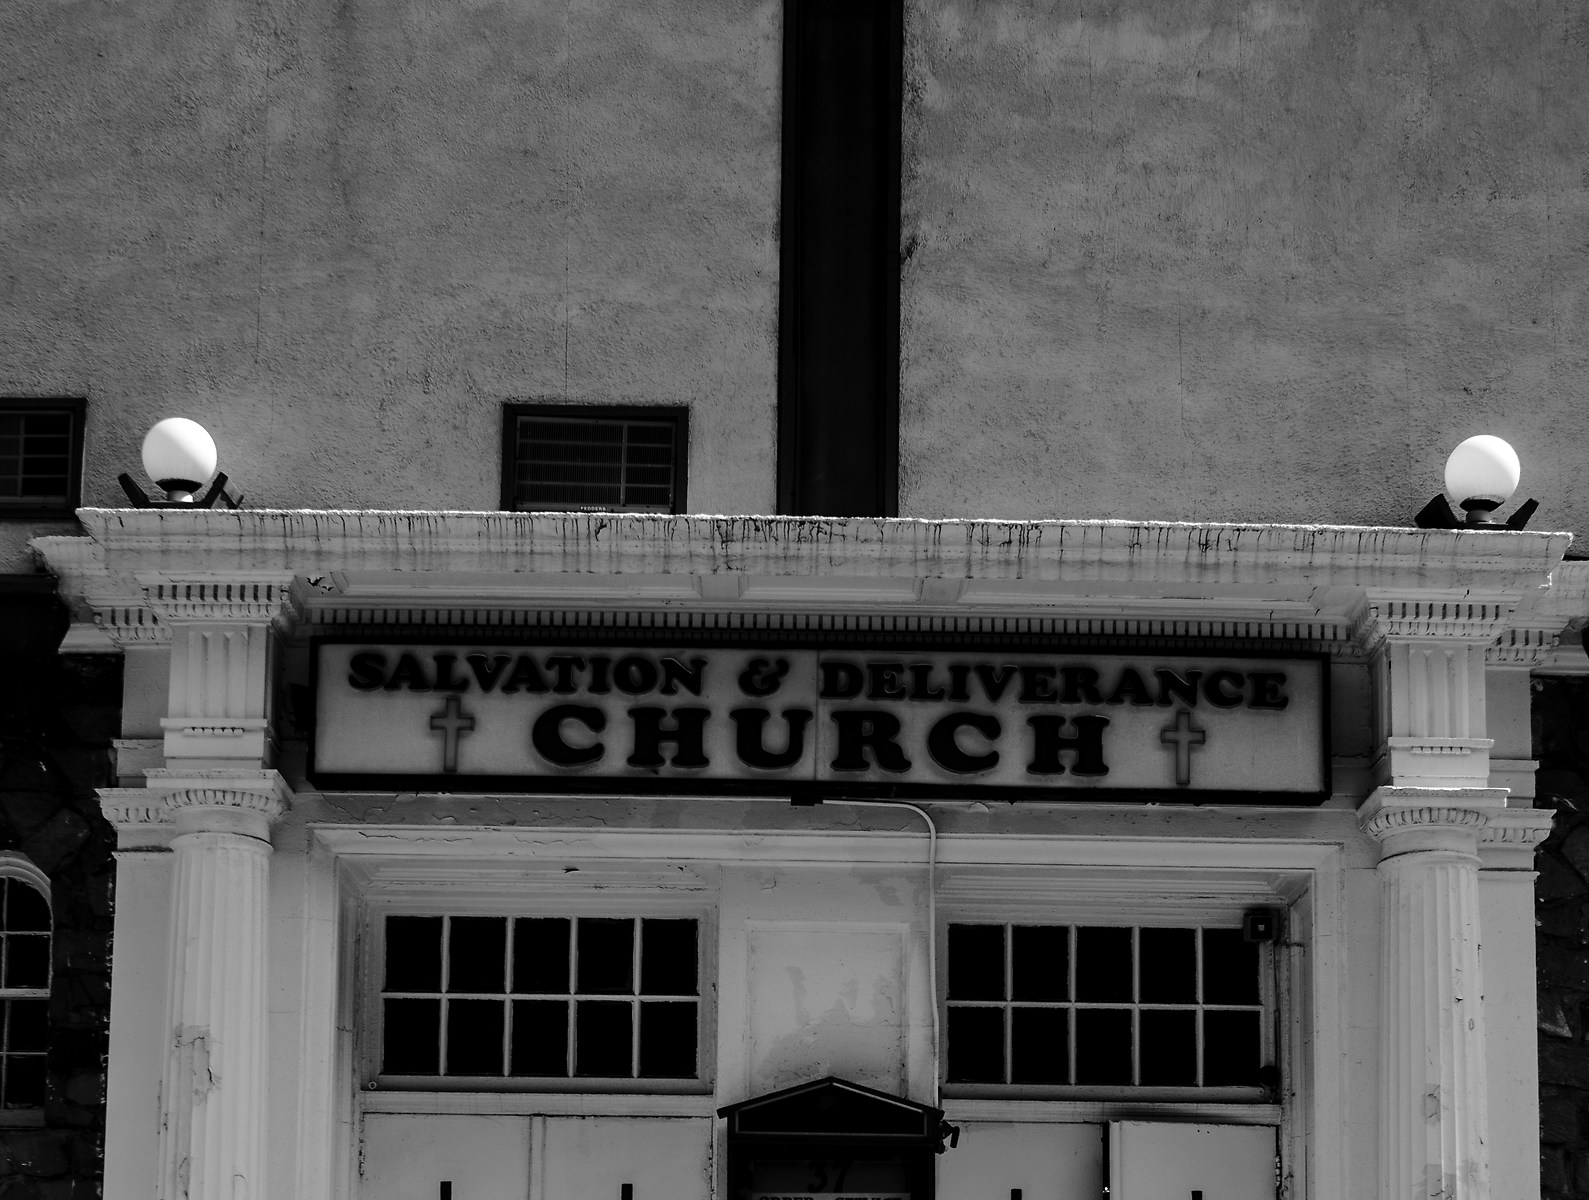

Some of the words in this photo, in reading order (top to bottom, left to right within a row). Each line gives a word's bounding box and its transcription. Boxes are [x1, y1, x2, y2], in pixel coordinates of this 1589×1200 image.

[348, 652, 708, 696] SALVATION
[738, 658, 790, 696] &
[820, 662, 1290, 710] DELIVERANCE
[532, 704, 1111, 776] CHURCH
